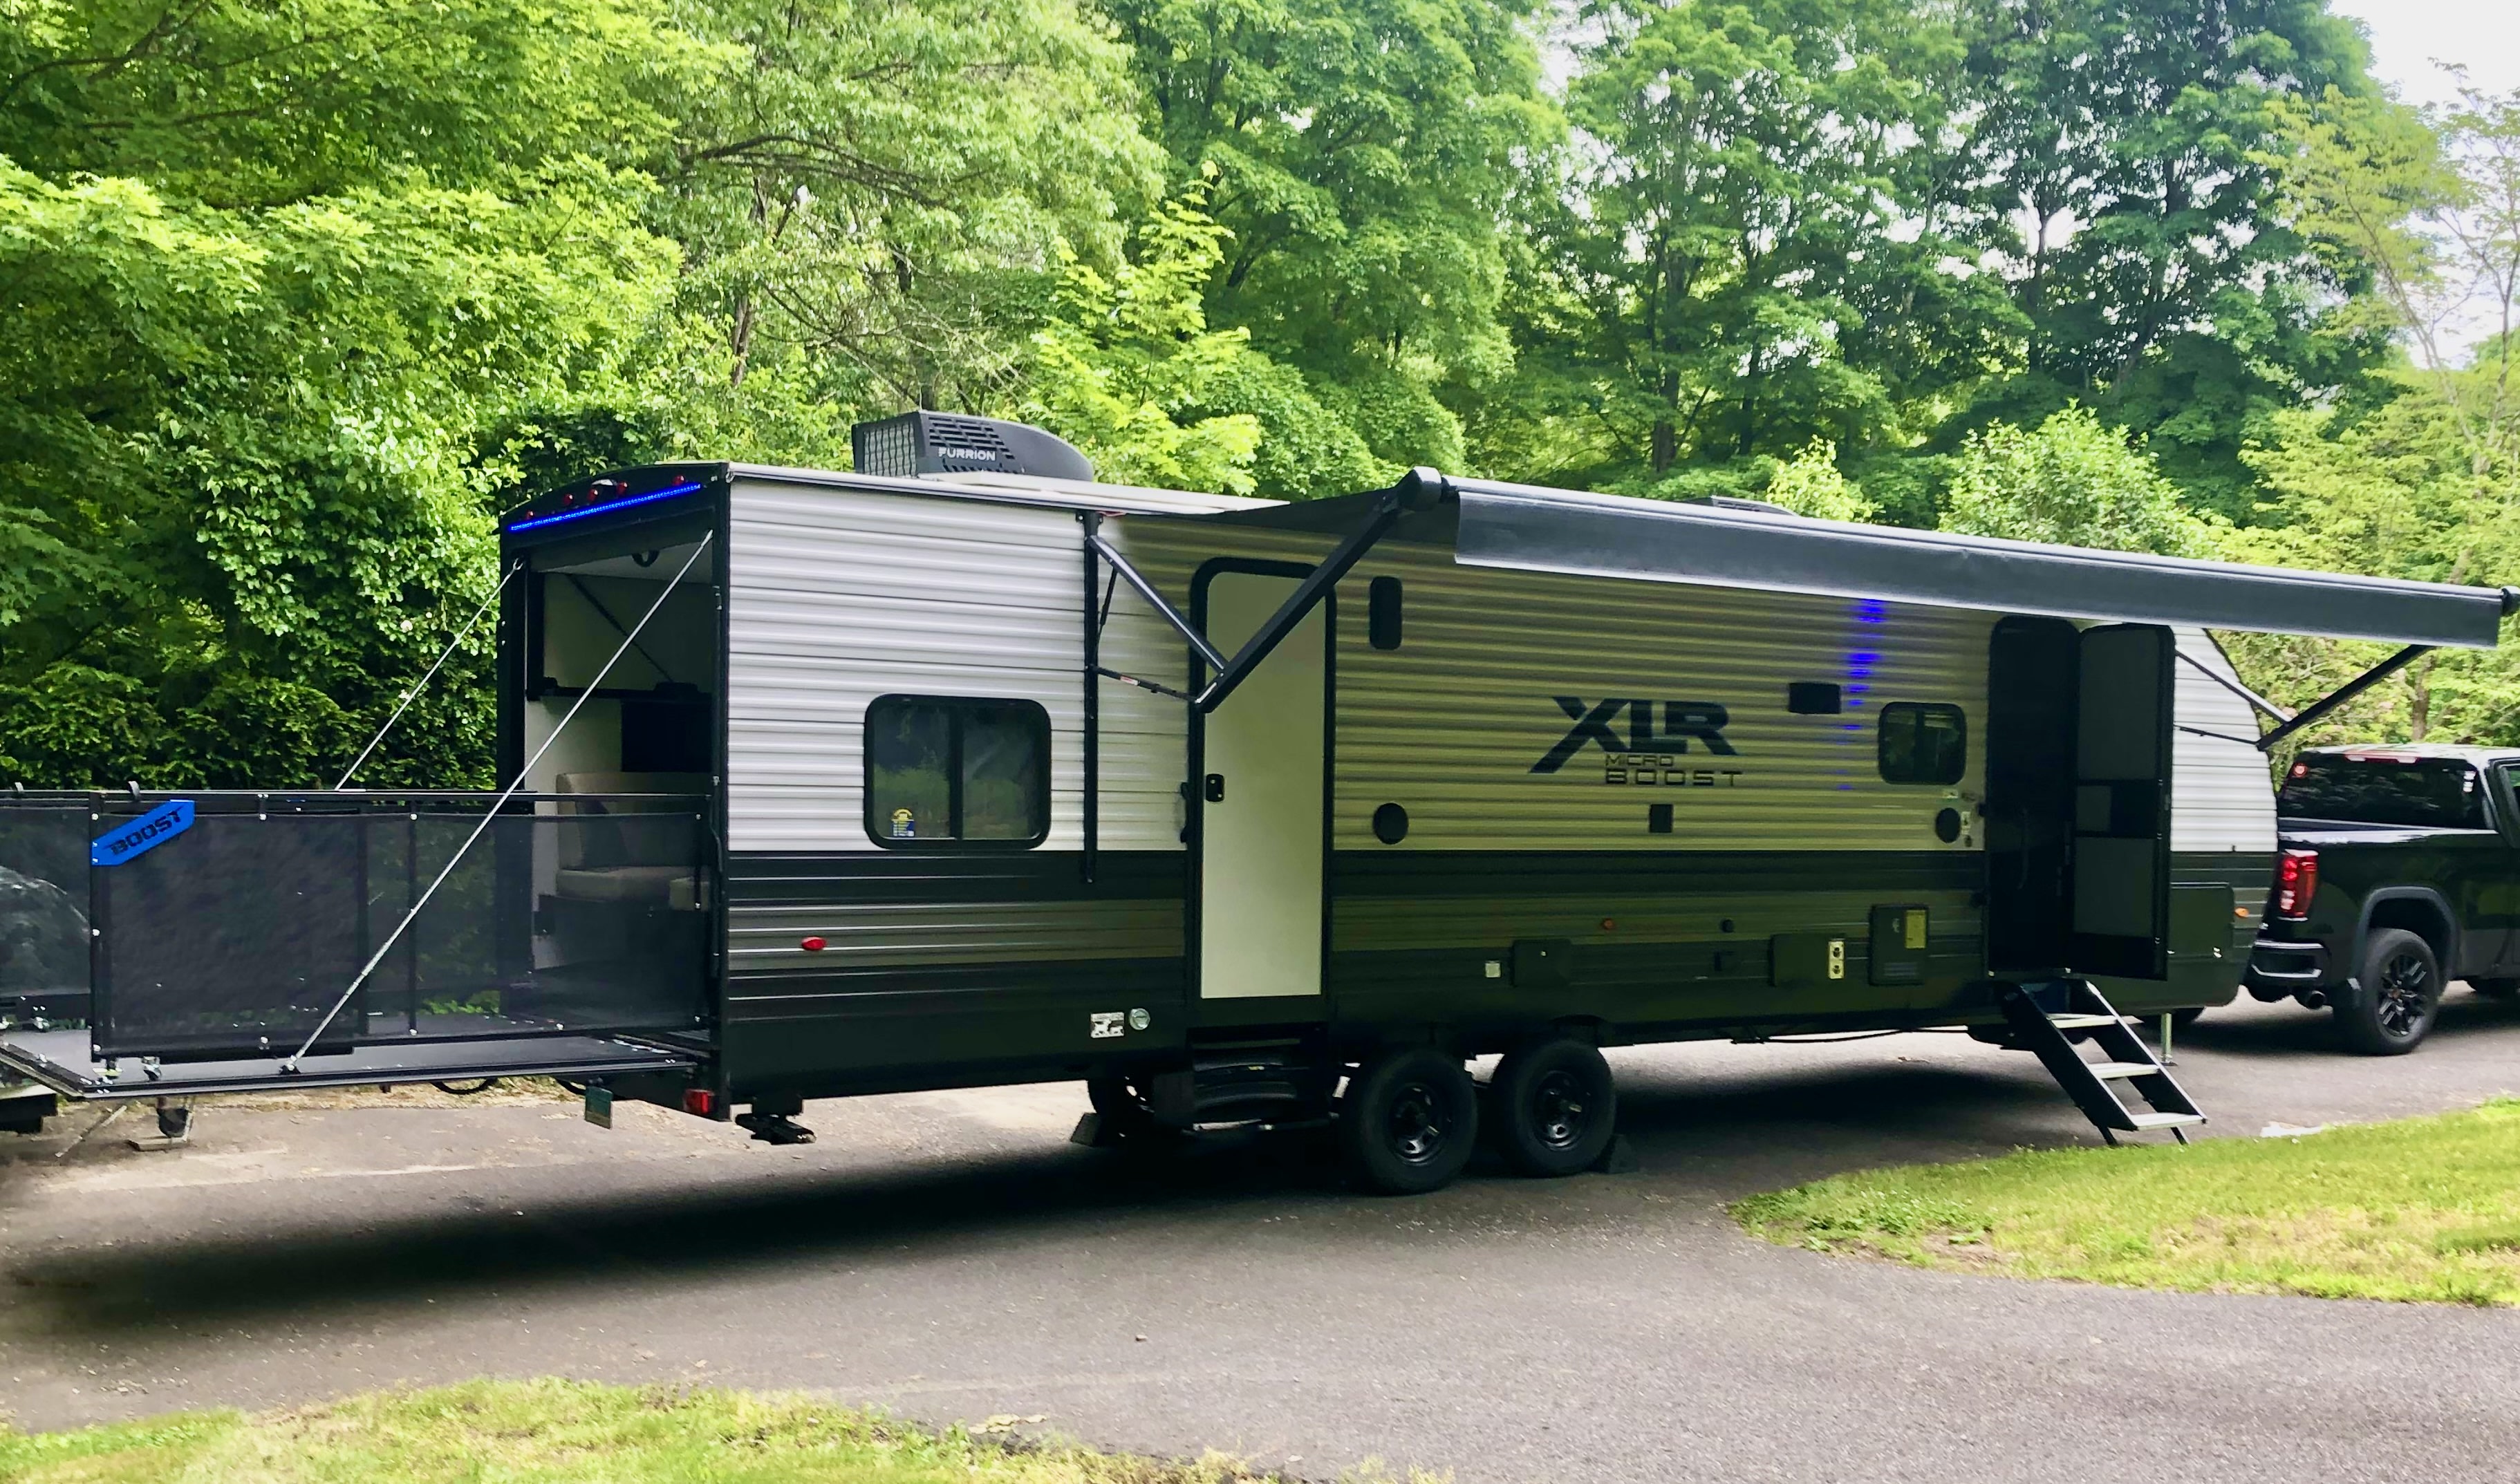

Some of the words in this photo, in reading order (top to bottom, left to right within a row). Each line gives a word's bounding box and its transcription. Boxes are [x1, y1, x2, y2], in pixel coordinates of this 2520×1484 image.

[938, 447, 996, 461] FURRION
[1528, 695, 1740, 774] XLR
[1605, 753, 1674, 767] MICRO
[1605, 768, 1743, 786] BOOST
[104, 807, 183, 856] BOOST
